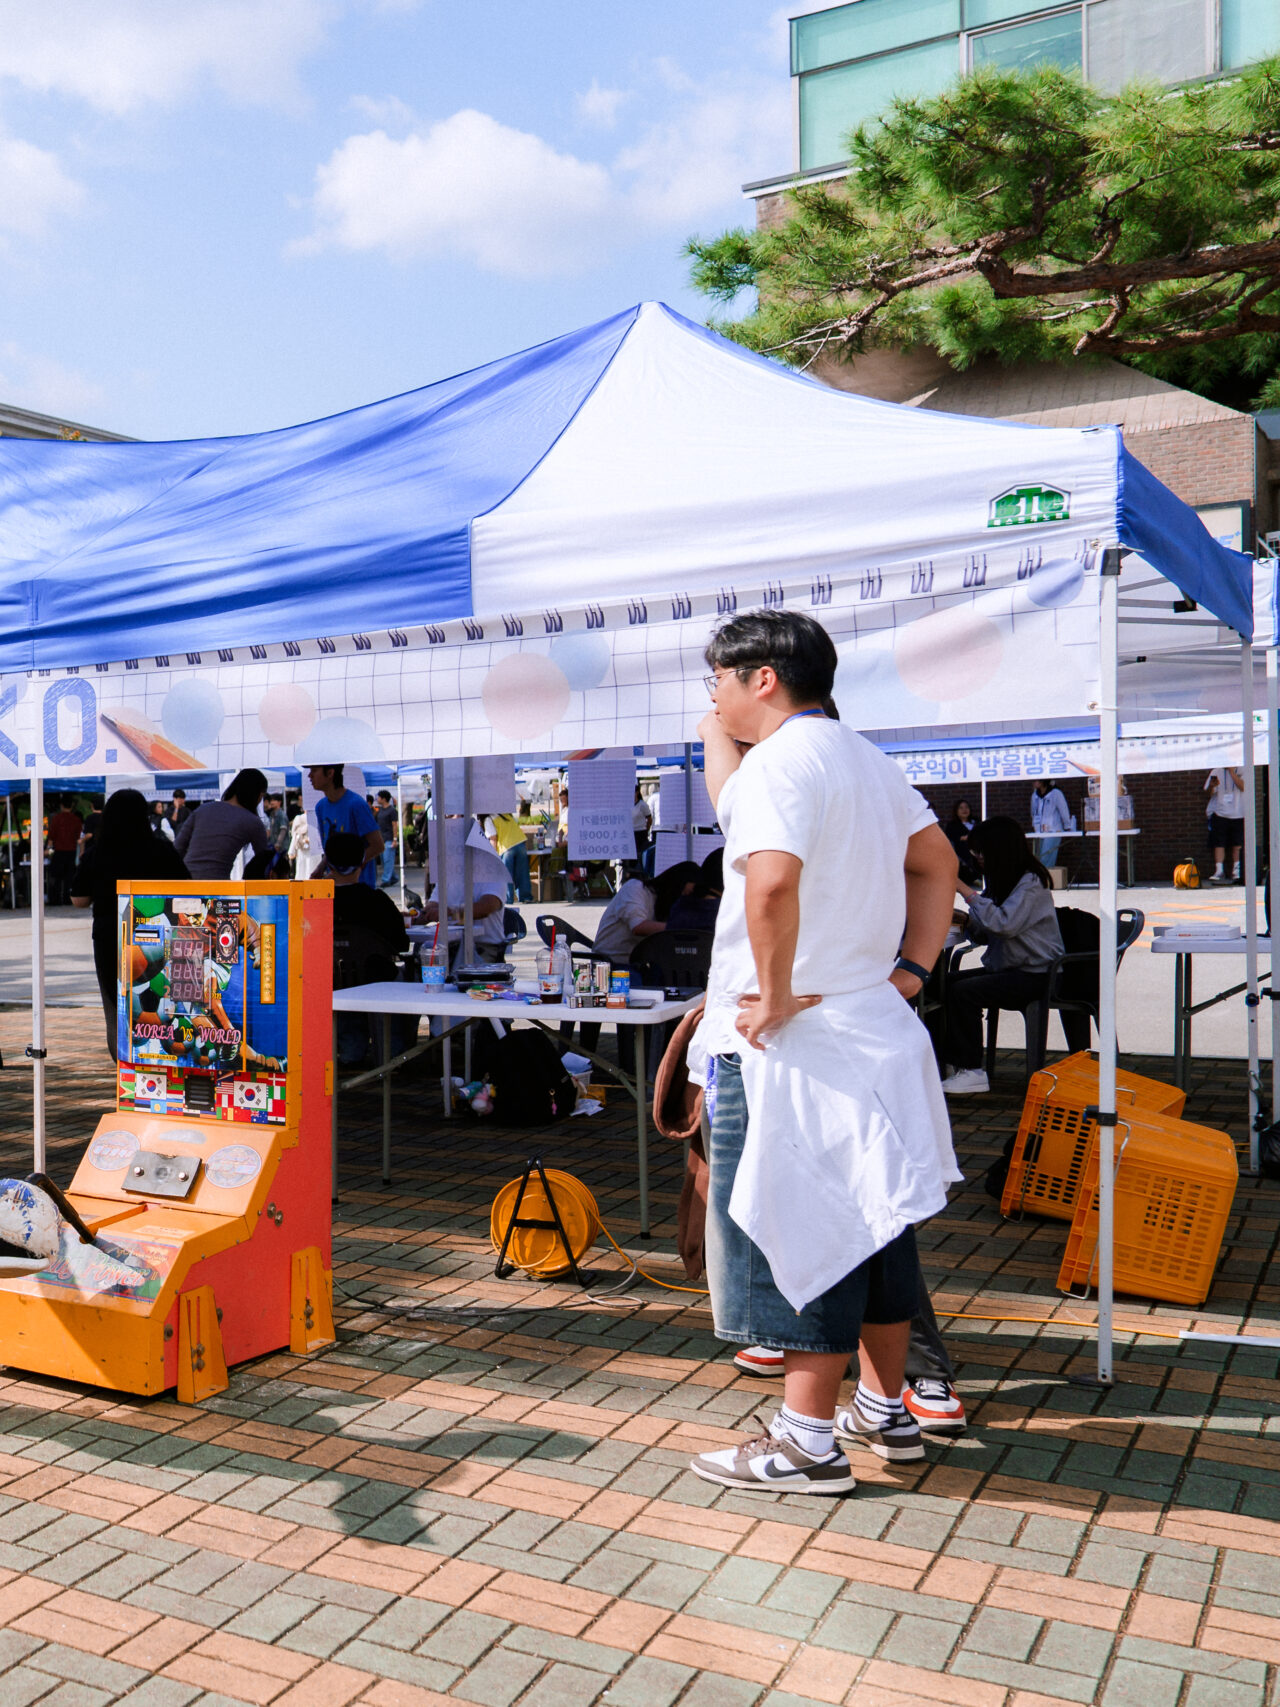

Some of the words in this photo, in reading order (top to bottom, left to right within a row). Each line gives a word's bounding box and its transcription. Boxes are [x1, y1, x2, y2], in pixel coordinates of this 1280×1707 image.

[905, 757, 967, 780] 추억이
[978, 751, 1067, 778] 방울방울
[134, 1023, 175, 1040] KOREA
[180, 1026, 194, 1042] VS
[198, 1025, 242, 1045] WORLD
